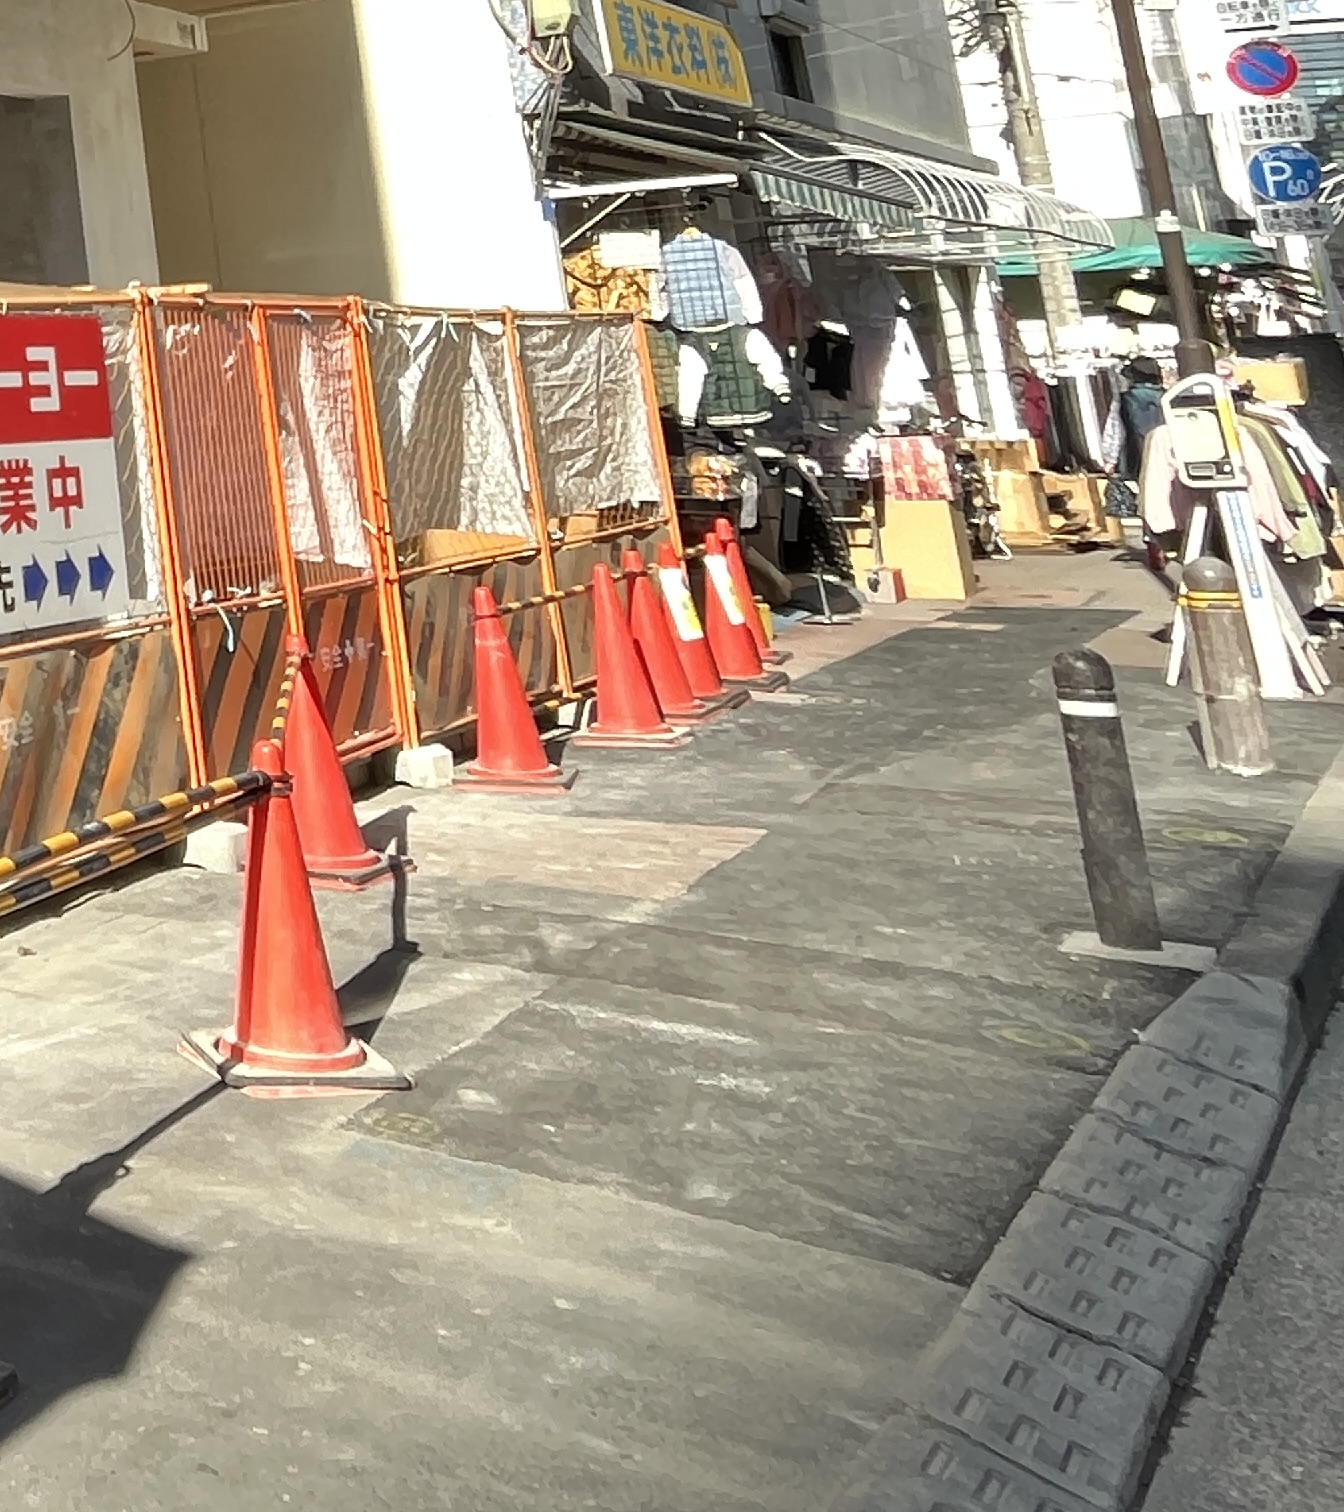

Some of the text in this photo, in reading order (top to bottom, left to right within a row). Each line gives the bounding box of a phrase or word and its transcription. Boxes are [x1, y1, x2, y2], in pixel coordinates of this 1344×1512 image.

[1219, 8, 1280, 24] 一方通行
[1263, 161, 1292, 198] P
